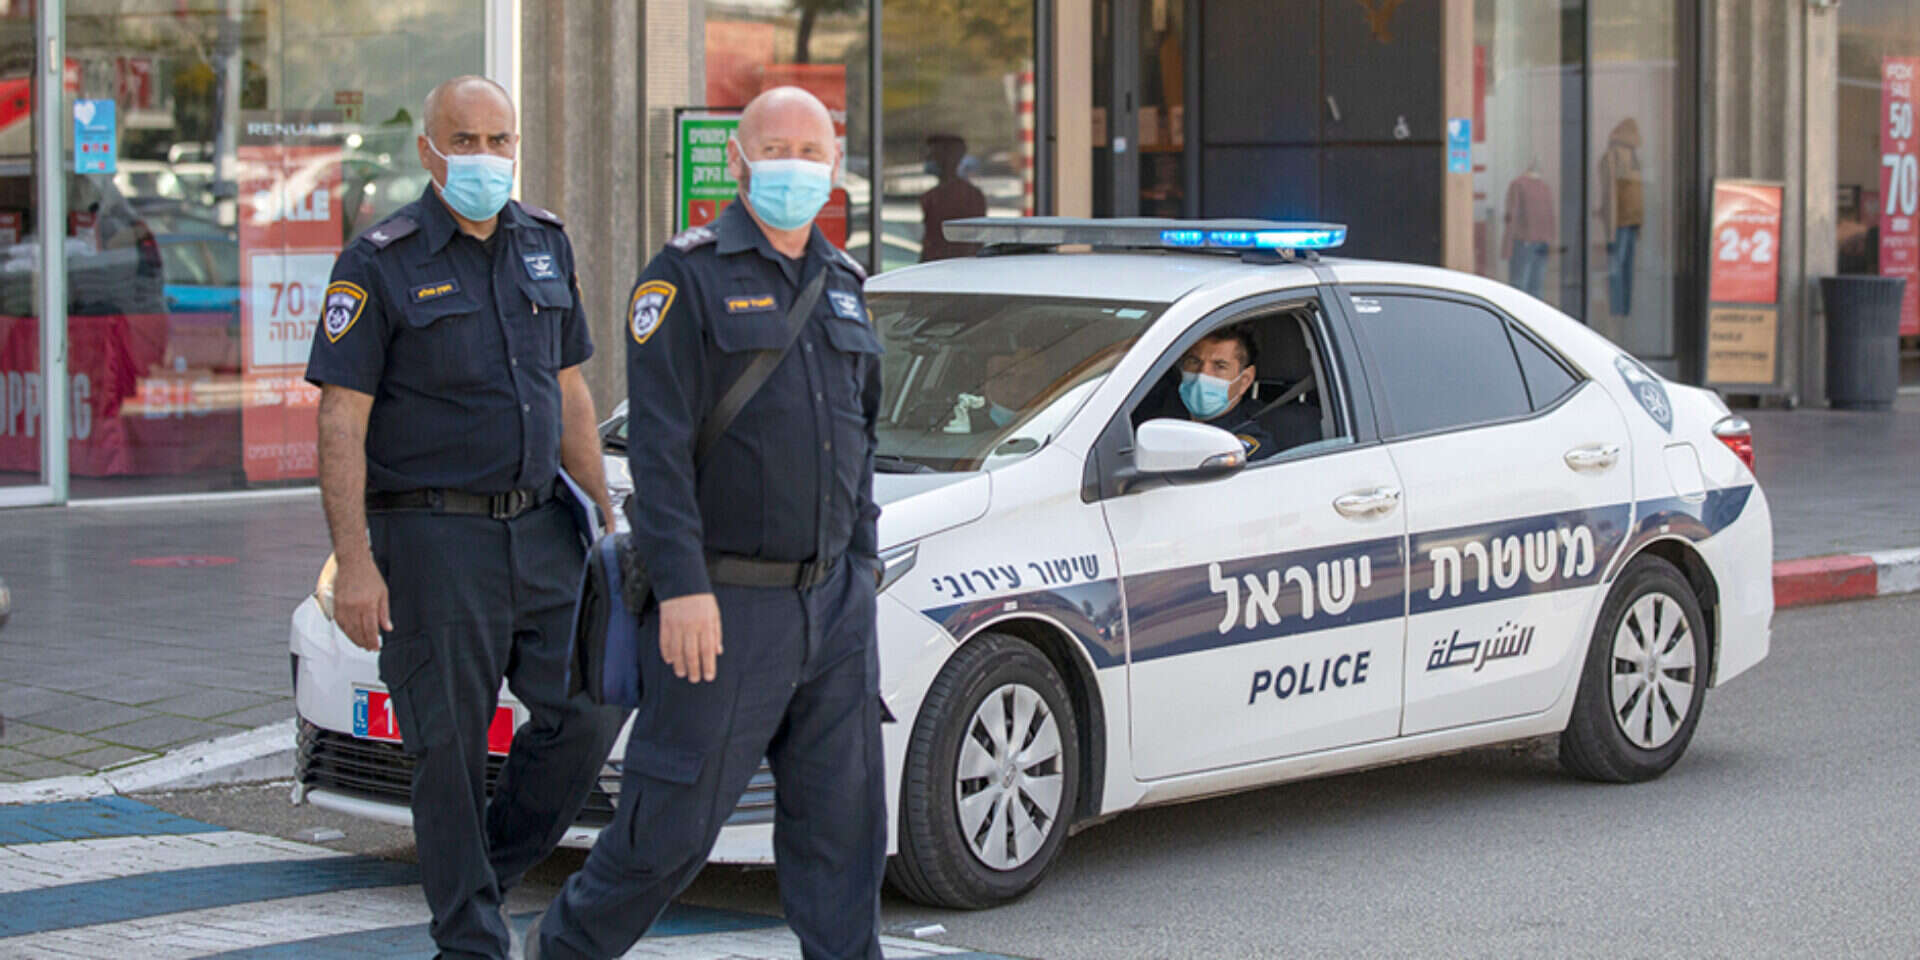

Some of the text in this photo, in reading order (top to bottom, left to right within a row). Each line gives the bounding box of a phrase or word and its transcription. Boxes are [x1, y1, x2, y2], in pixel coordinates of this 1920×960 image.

[1889, 102, 1912, 138] 50
[1882, 154, 1917, 215] 70
[269, 282, 304, 317] 70
[1028, 554, 1100, 585] שיטור
[1209, 525, 1595, 634] משטרת ישראל
[1426, 620, 1535, 673] الشرطة
[1248, 651, 1371, 706] POLICE
